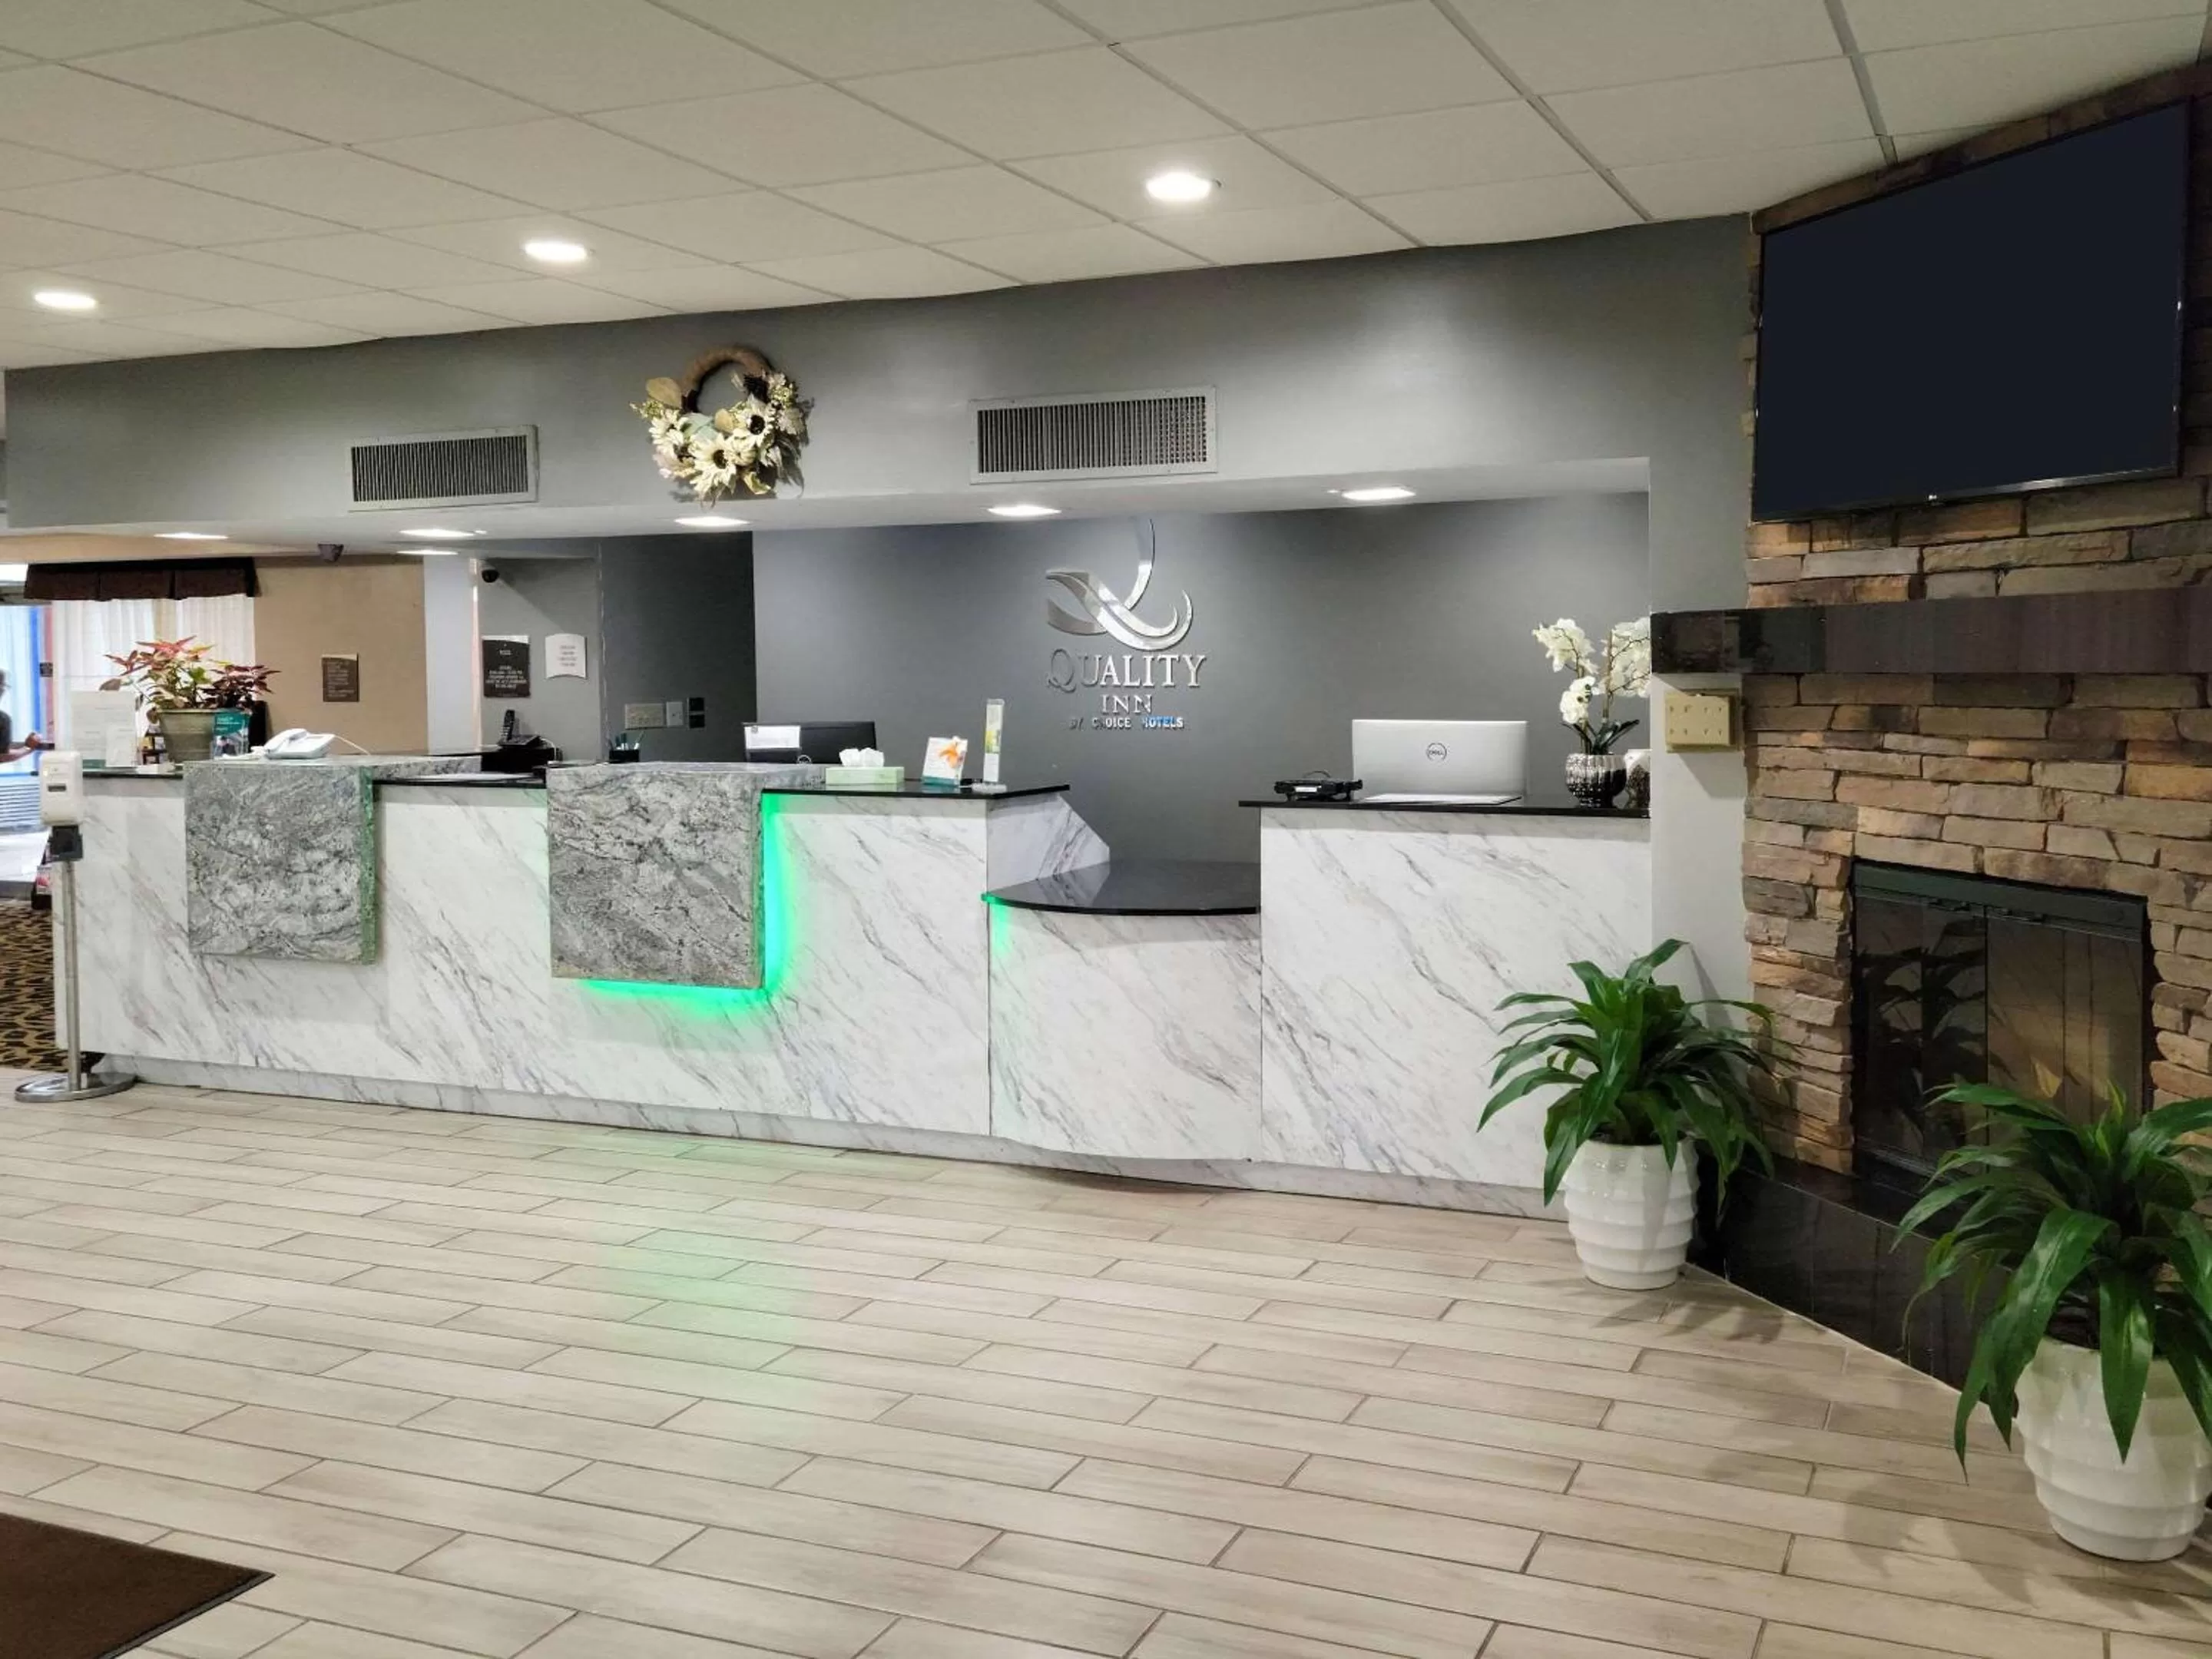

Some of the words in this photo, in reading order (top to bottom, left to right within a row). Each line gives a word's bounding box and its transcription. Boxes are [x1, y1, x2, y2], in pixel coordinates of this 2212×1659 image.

[1048, 649, 1207, 693] QUALITY
[1100, 694, 1153, 714] INN
[1091, 717, 1132, 729] COICE
